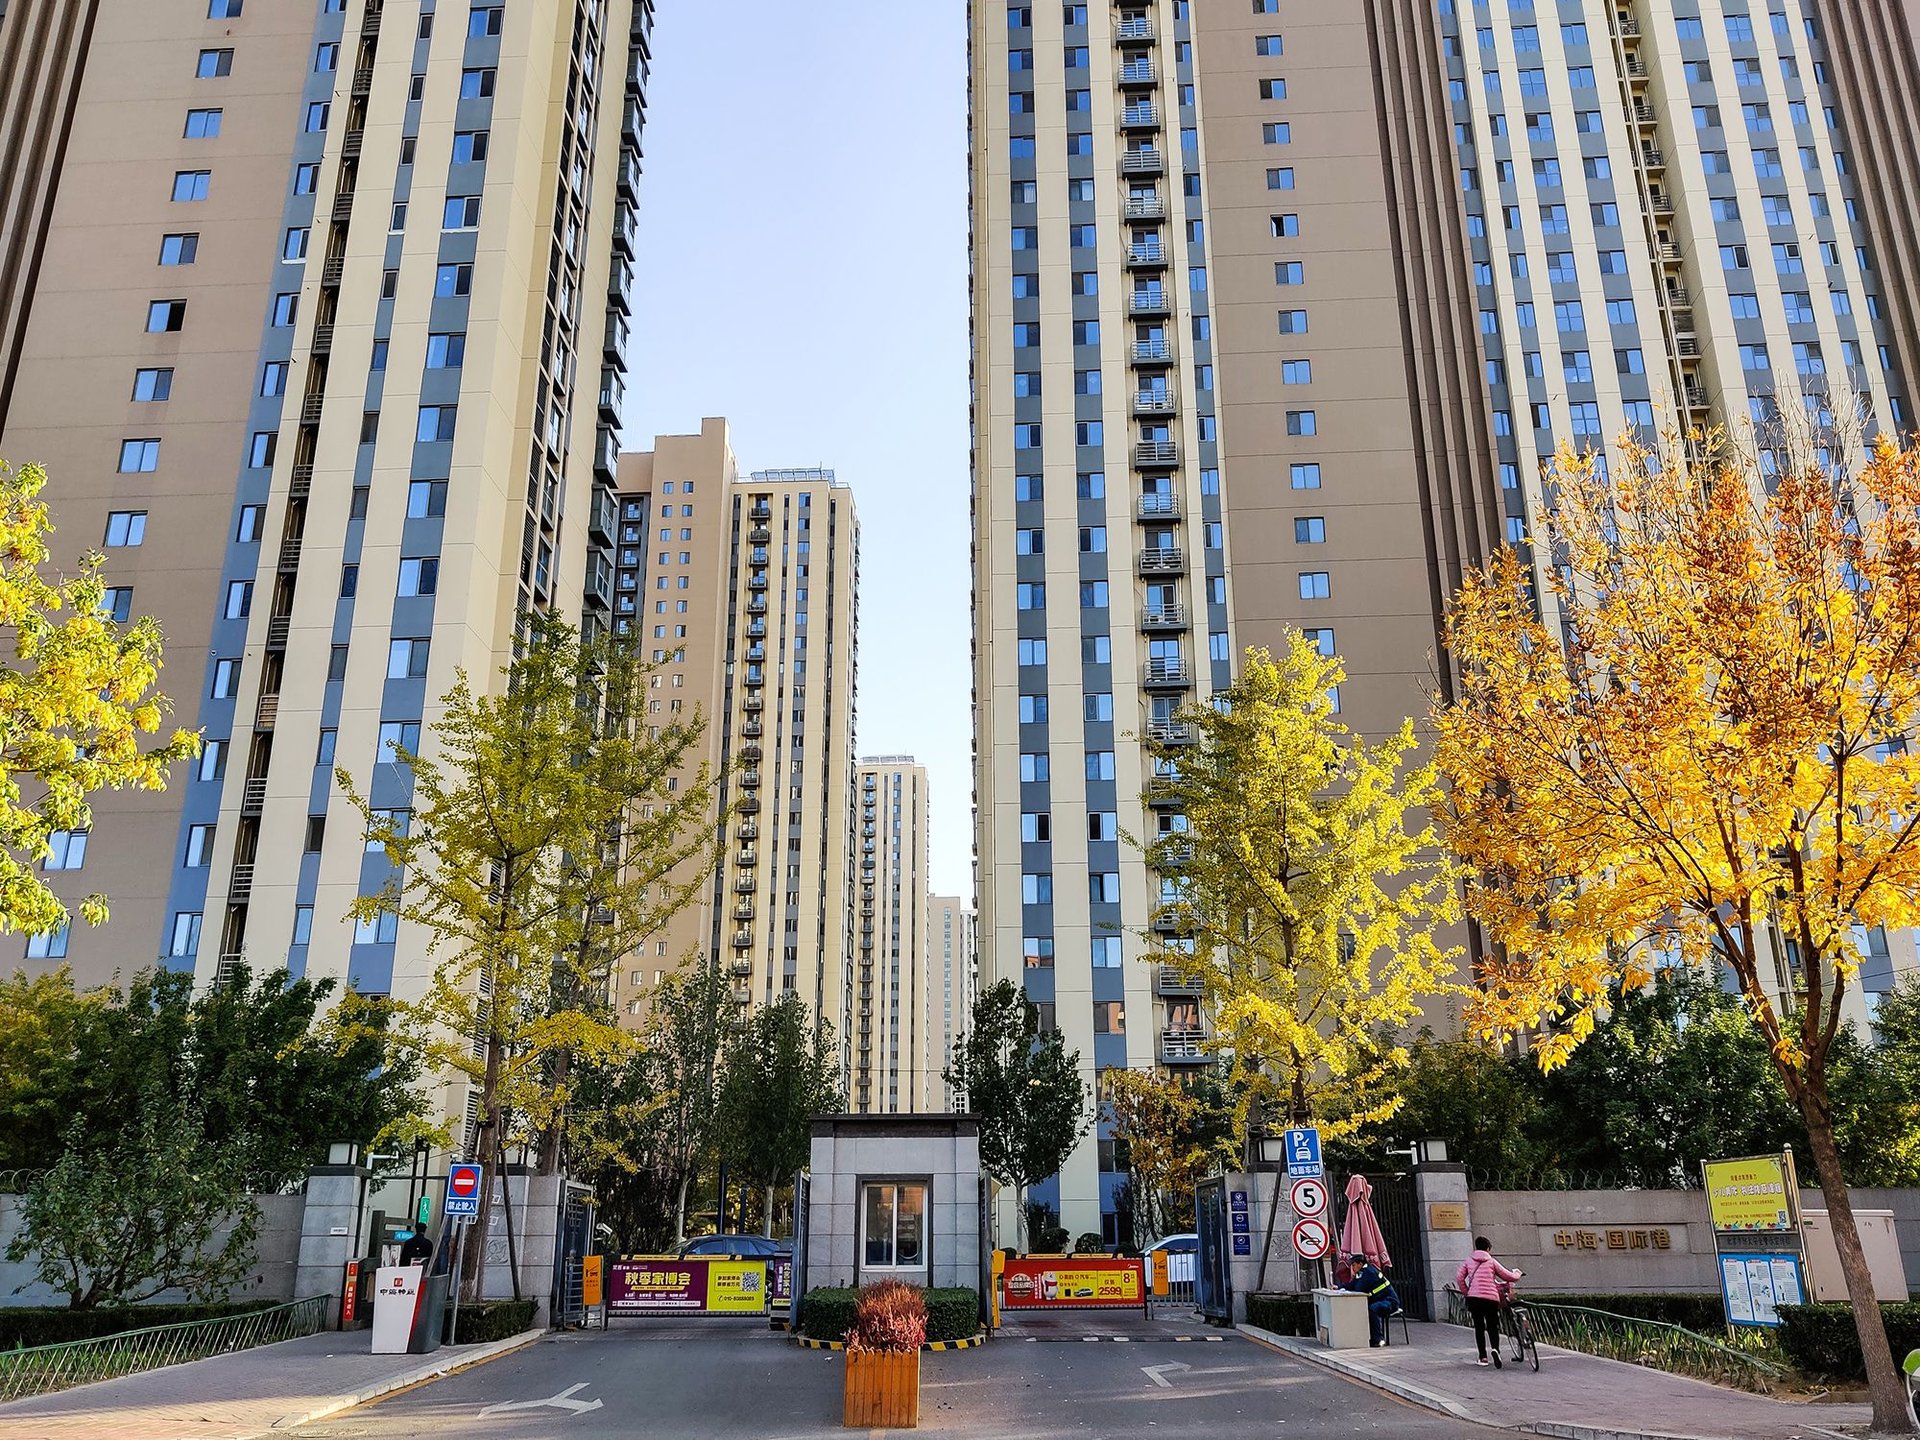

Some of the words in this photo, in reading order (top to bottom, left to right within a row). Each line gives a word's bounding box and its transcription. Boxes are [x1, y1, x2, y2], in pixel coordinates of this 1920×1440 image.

[1293, 1132, 1304, 1147] P
[1290, 1163, 1320, 1175] 地面车场
[1303, 1188, 1316, 1208] 5
[447, 1201, 475, 1211] 禁止驶入
[624, 1272, 691, 1286] 秋季家博会
[1123, 1272, 1131, 1283] 8
[1098, 1286, 1122, 1296] 2599
